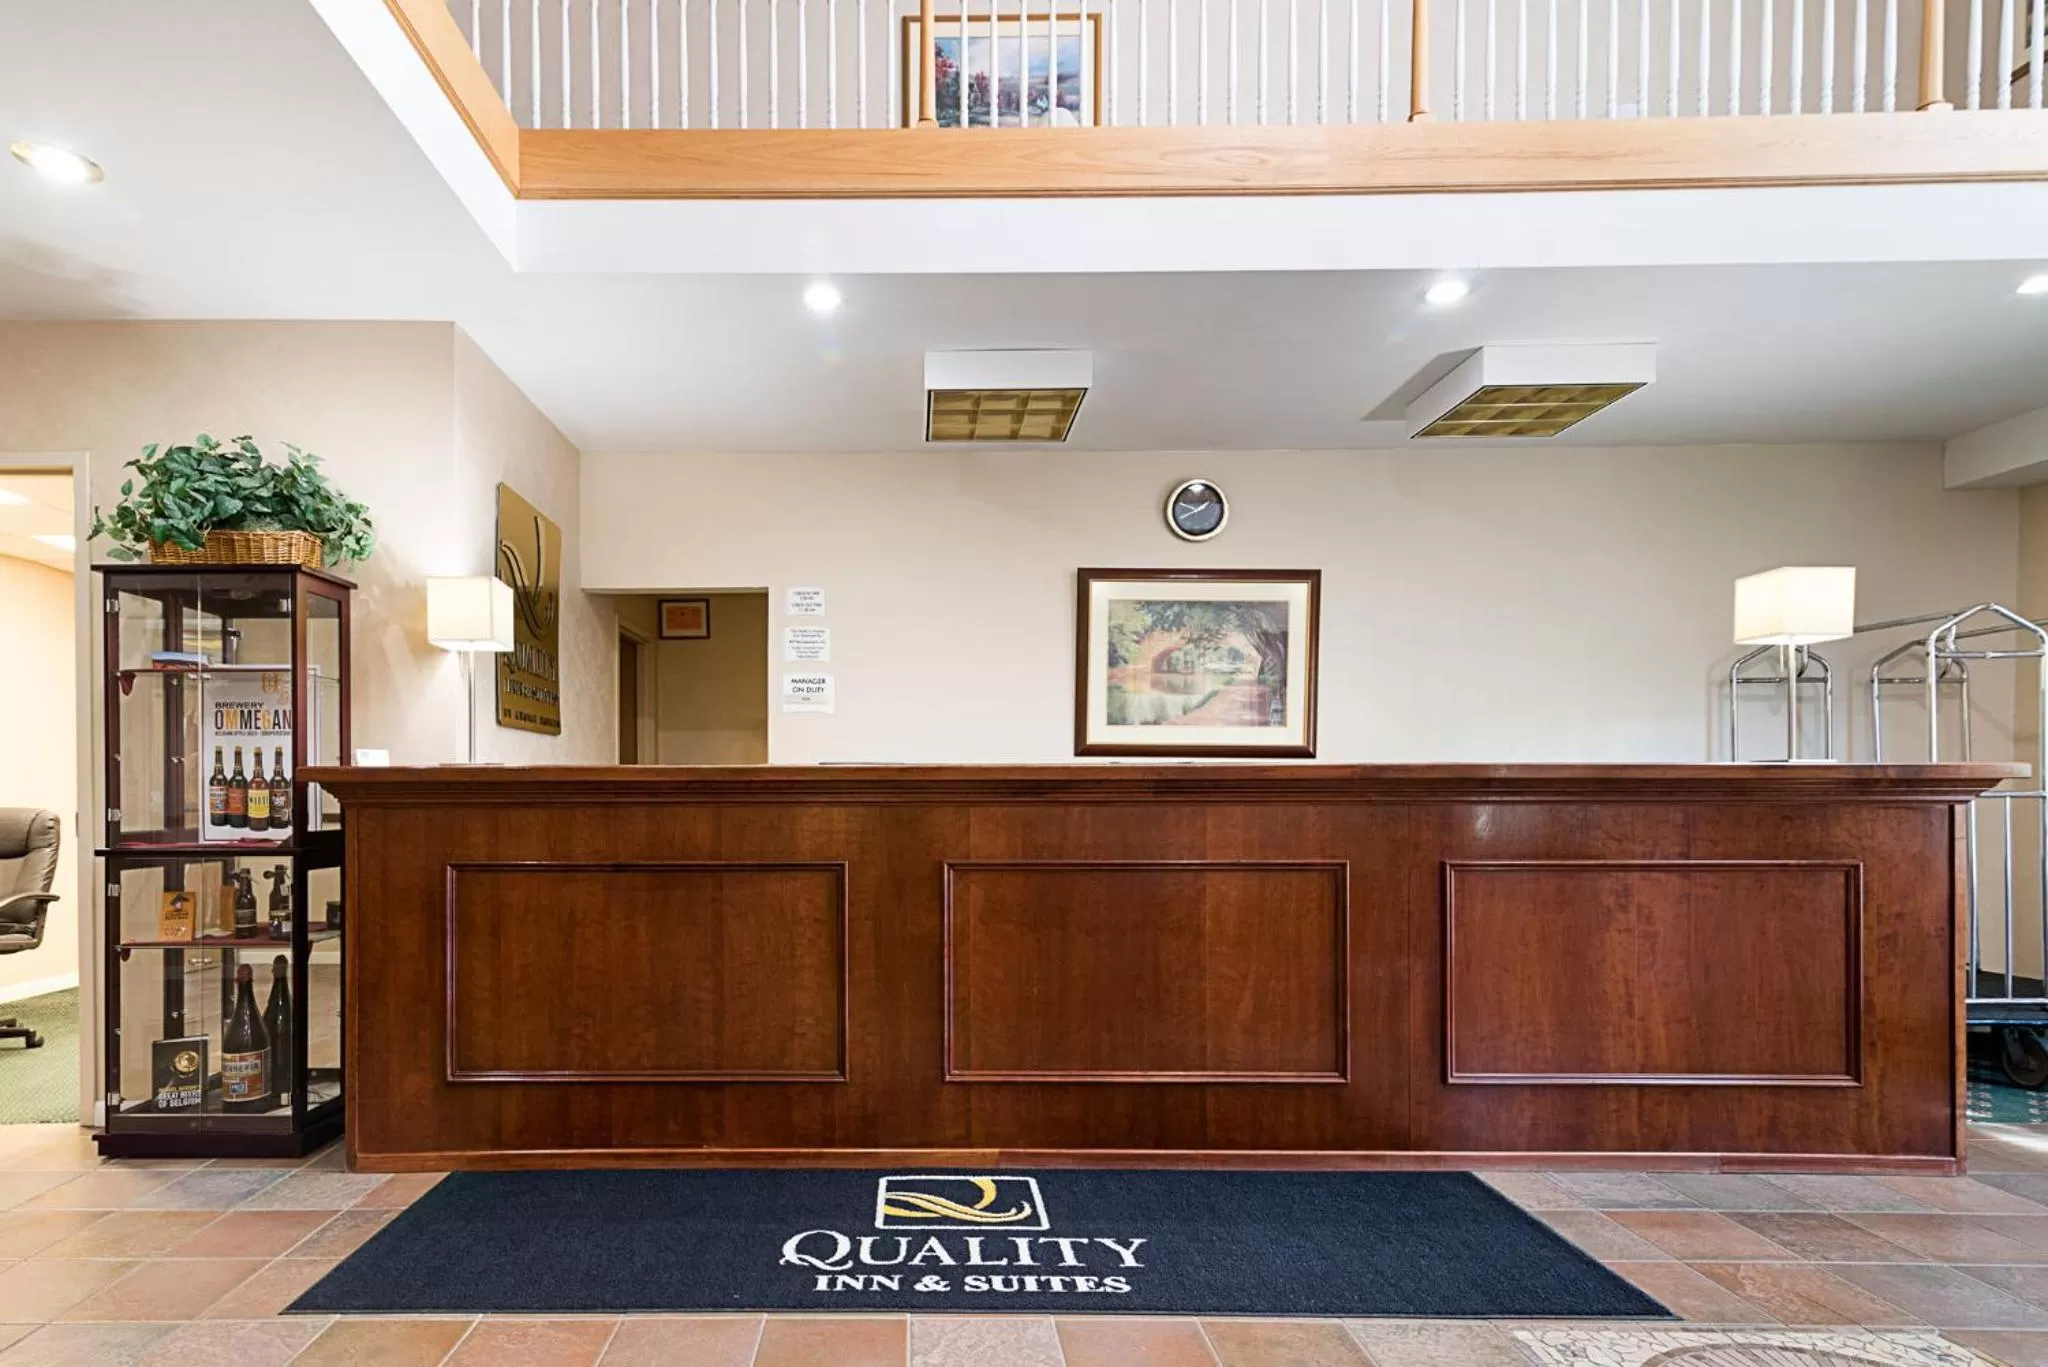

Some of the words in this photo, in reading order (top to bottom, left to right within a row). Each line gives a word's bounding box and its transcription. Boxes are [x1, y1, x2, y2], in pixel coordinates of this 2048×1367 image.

[215, 701, 264, 709] BREWERY
[779, 1230, 1148, 1270] QUALITY
[813, 1275, 903, 1291] INN
[913, 1275, 951, 1292] &
[963, 1275, 1132, 1293] SUITES
